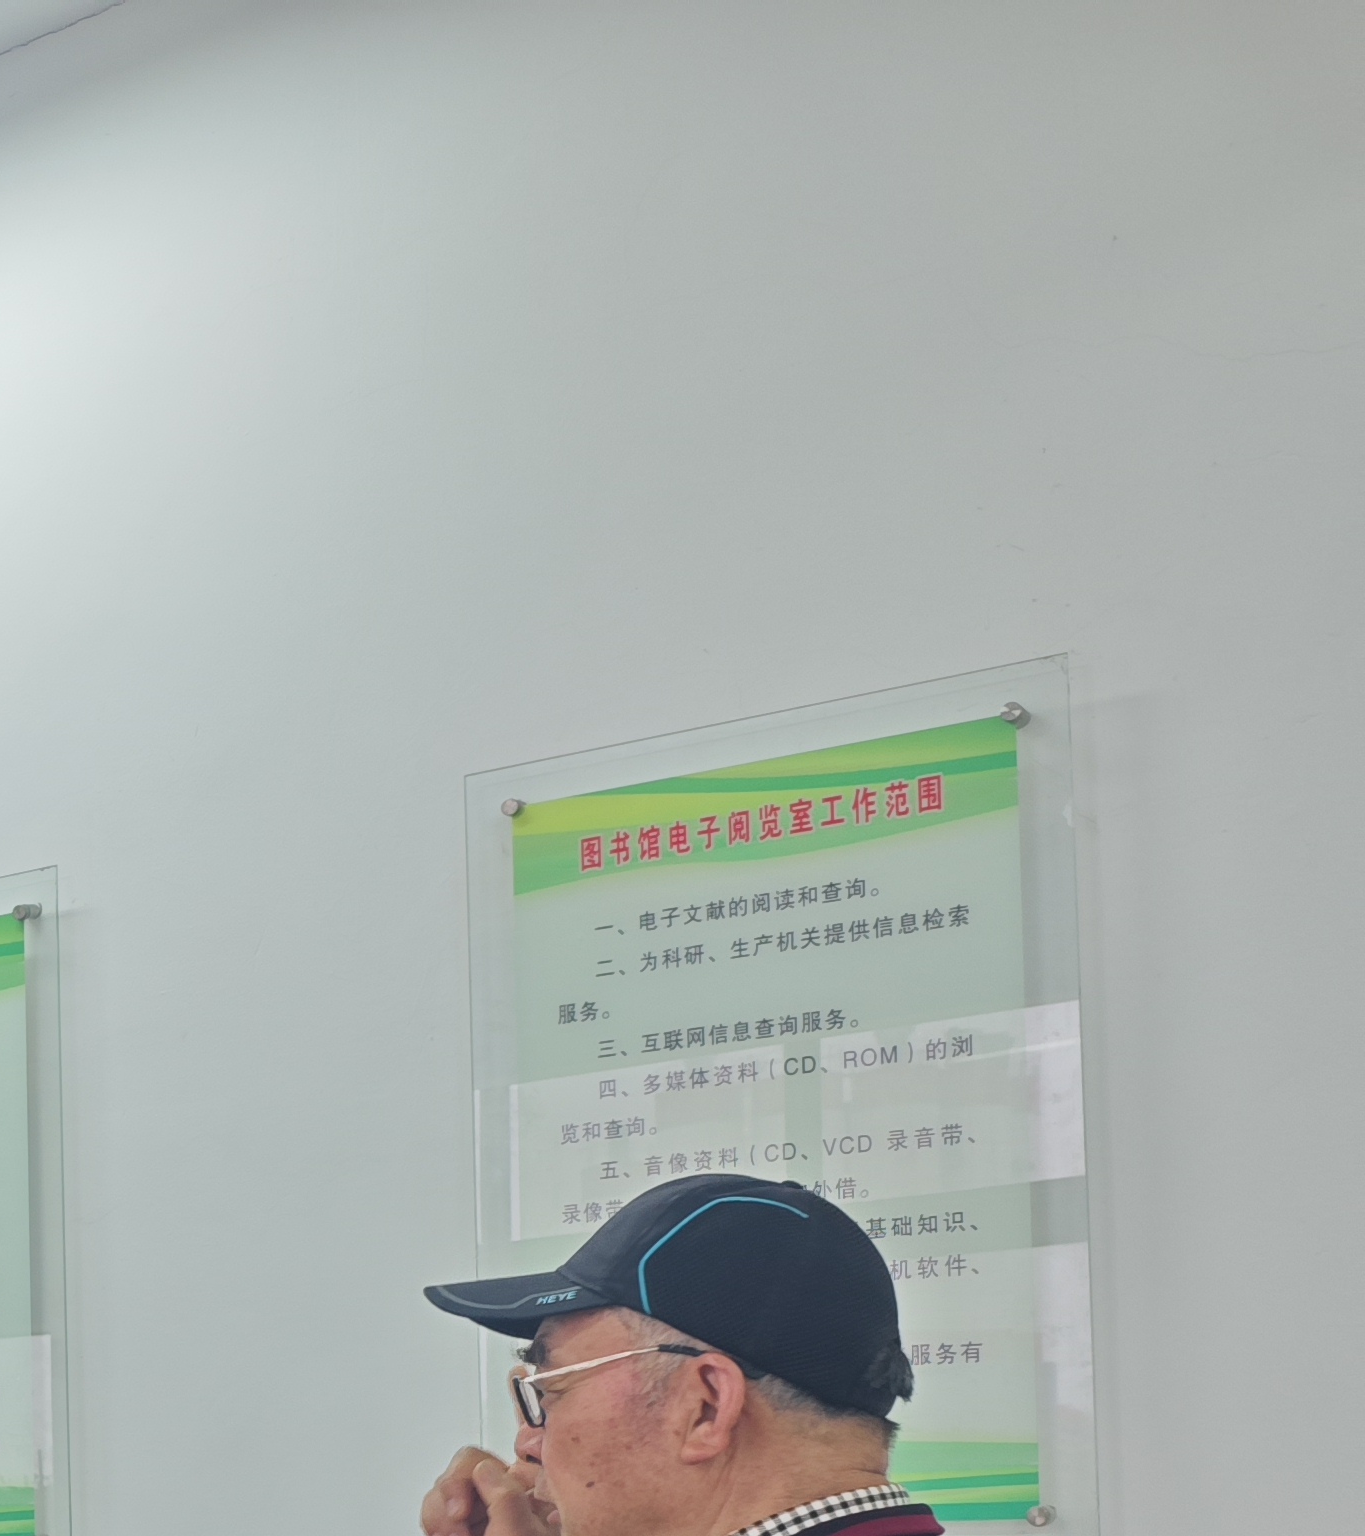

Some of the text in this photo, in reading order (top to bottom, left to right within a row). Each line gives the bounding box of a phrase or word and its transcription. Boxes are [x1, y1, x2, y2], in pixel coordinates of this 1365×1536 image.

[579, 774, 945, 873] 图书馆电子阅览室工作范围
[594, 877, 881, 937] 一、电子文献的阅读和查询。
[595, 904, 971, 979] 二、为科研、生产机关提供信息检索
[557, 1001, 612, 1026] 服务。
[597, 1008, 861, 1060] 三、互联网信息查询服务。
[560, 1116, 658, 1146] 览和查询。
